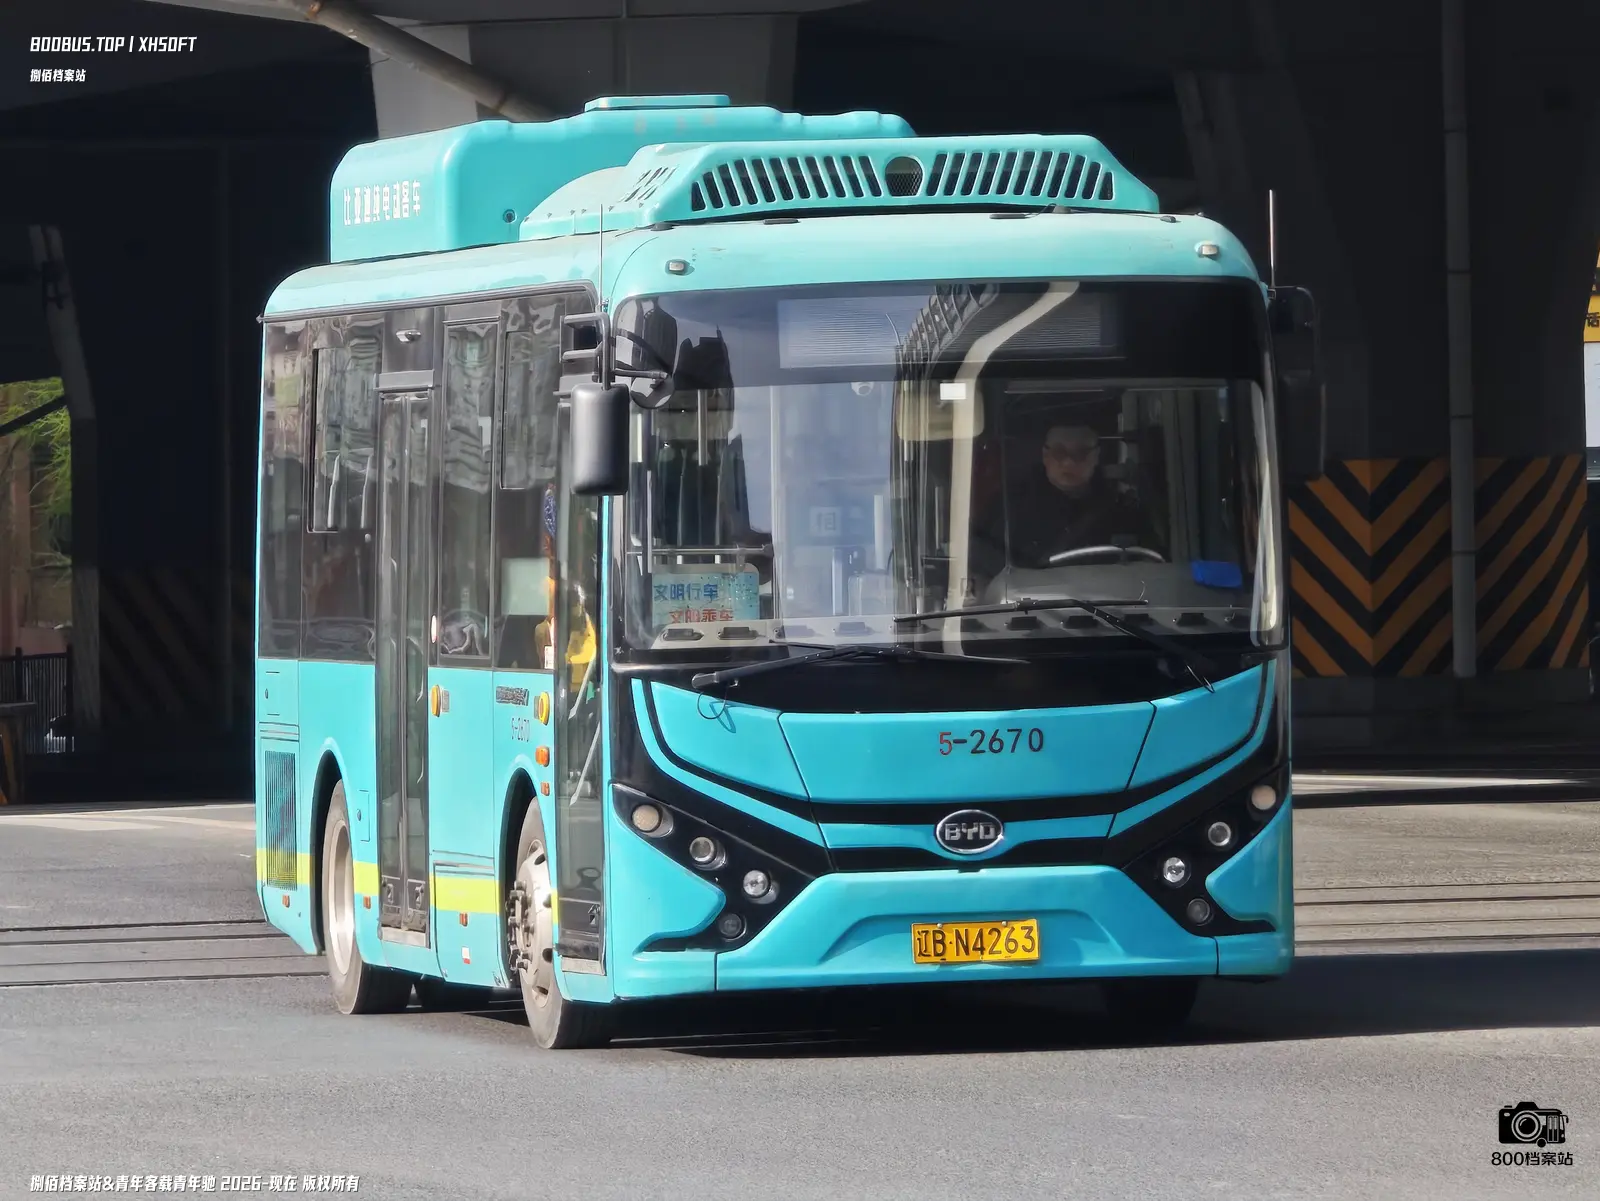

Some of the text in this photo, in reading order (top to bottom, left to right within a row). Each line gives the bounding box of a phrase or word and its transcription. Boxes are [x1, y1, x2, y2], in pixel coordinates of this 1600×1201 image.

[653, 583, 719, 603] 文明行车
[939, 728, 1044, 756] 5-2670
[944, 822, 996, 841] BYD
